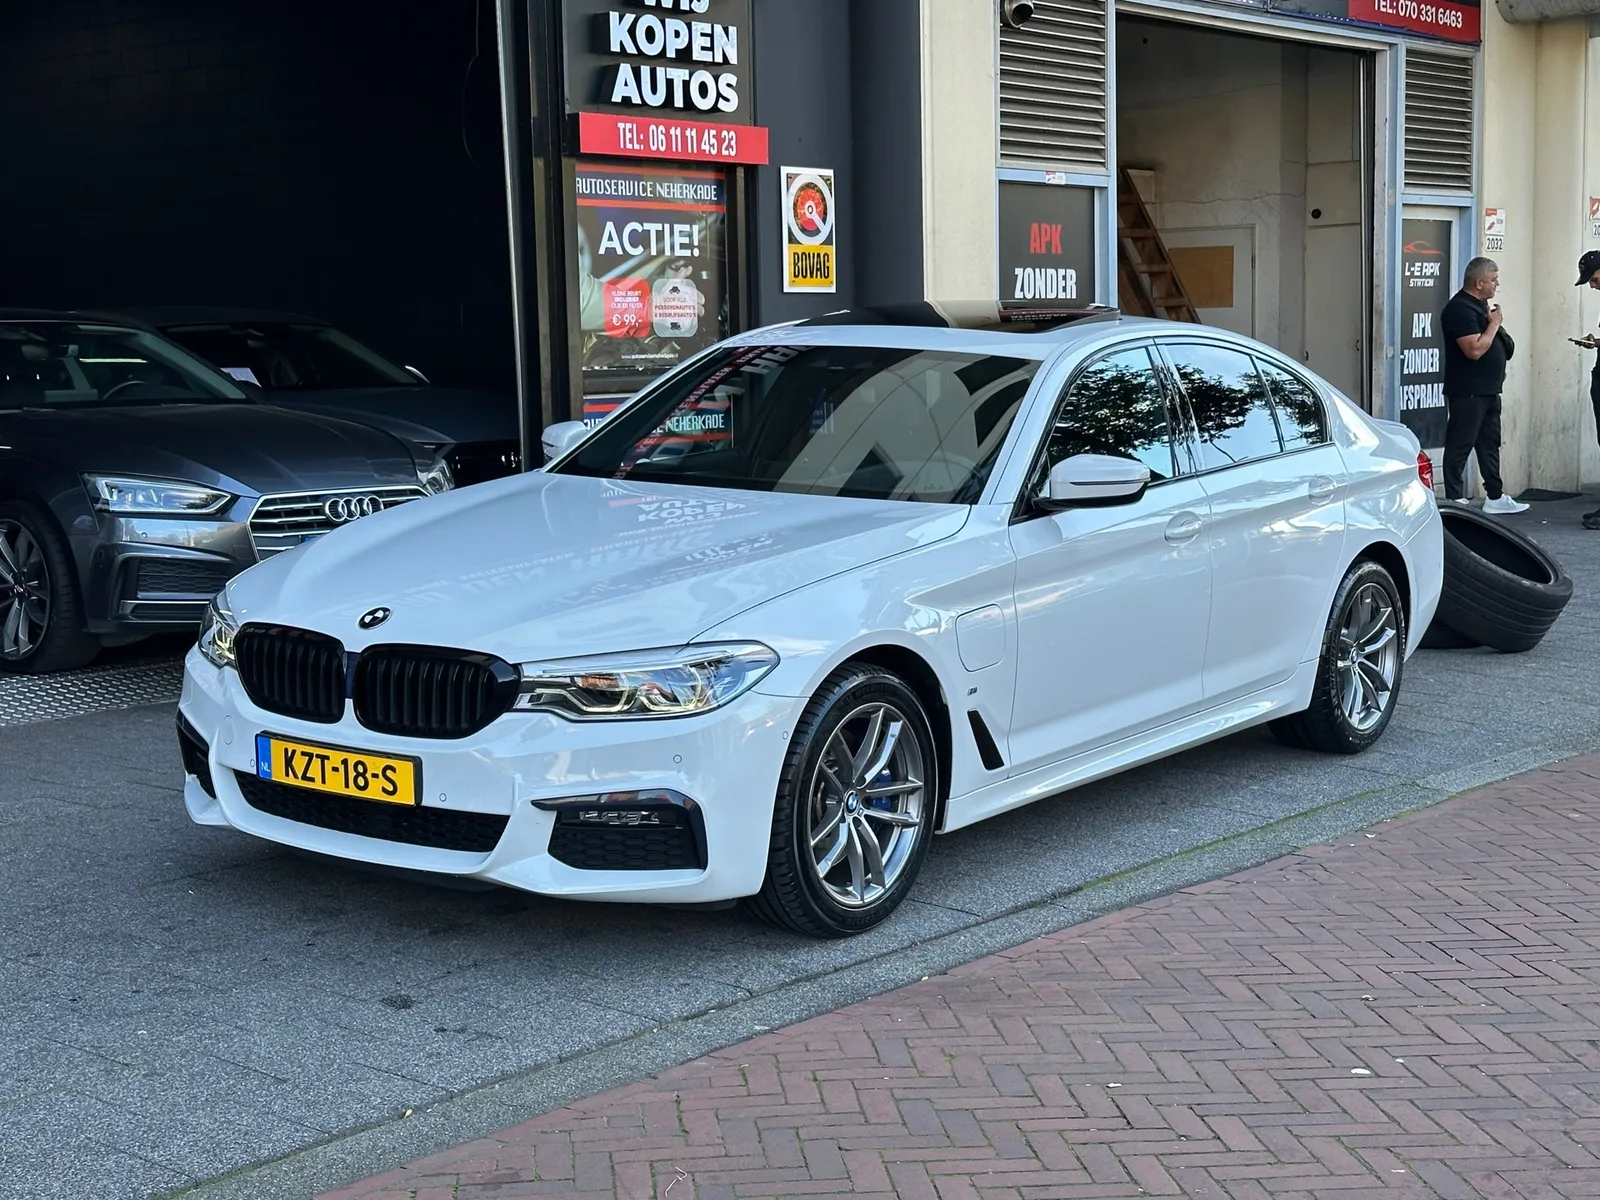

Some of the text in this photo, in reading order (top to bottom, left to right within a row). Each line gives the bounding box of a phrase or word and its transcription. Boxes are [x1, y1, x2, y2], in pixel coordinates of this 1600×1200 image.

[1398, 0, 1418, 19] 070
[1420, 4, 1436, 24] 331
[1438, 8, 1463, 29] 6463
[609, 11, 738, 65] KOPEN
[611, 62, 739, 113] AUTOS
[617, 122, 737, 157] TEL: 06 11 11 45 23
[576, 177, 718, 201] AUTOSERVICE NEHERKADE
[598, 221, 700, 258] ACTIE!
[1030, 223, 1063, 254] APK
[1487, 238, 1503, 250] 2032
[793, 251, 830, 279] BOVAG
[1404, 262, 1441, 276] L-E APK
[1014, 267, 1077, 299] ZONDER
[1409, 278, 1434, 287] STATION
[623, 313, 643, 327] 99,-
[1412, 313, 1432, 338] APK
[1403, 348, 1440, 374] ZONDER
[665, 413, 725, 432] NEHERKADE
[261, 747, 398, 797] NL KZT-18-S
